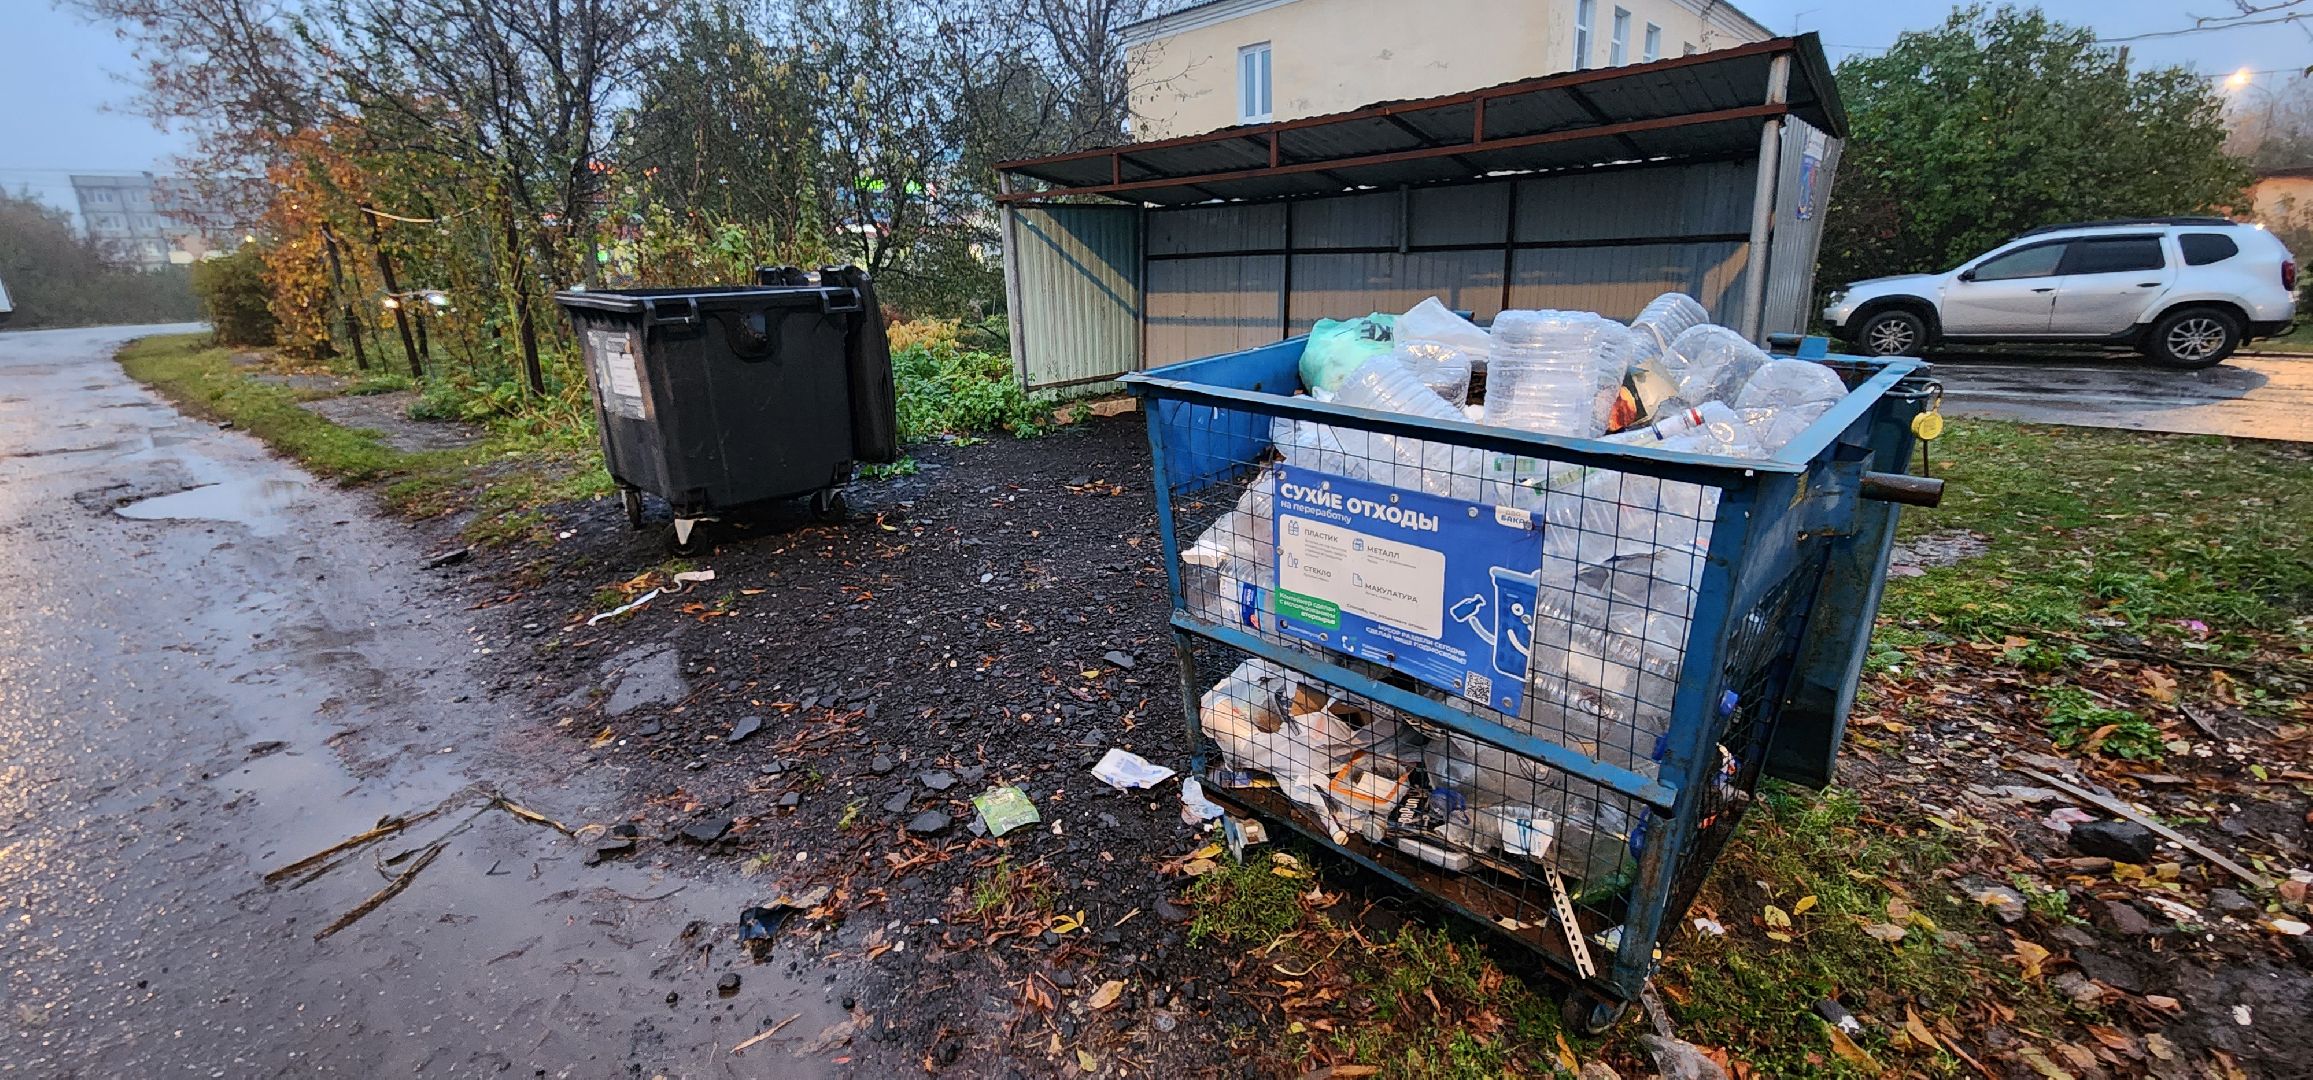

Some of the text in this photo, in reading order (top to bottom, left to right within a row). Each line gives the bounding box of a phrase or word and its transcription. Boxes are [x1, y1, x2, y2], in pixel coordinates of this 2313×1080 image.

[1281, 483, 1439, 532] СУХИЕ ОТХОДЫ
[1281, 500, 1352, 525] на переработку
[1304, 528, 1339, 543] ПЛАСТИК
[1367, 545, 1400, 559] МЕТАЛЛ
[1303, 565, 1332, 578] СТЕКЛО
[1364, 582, 1418, 603] МАКУЛАТУРА
